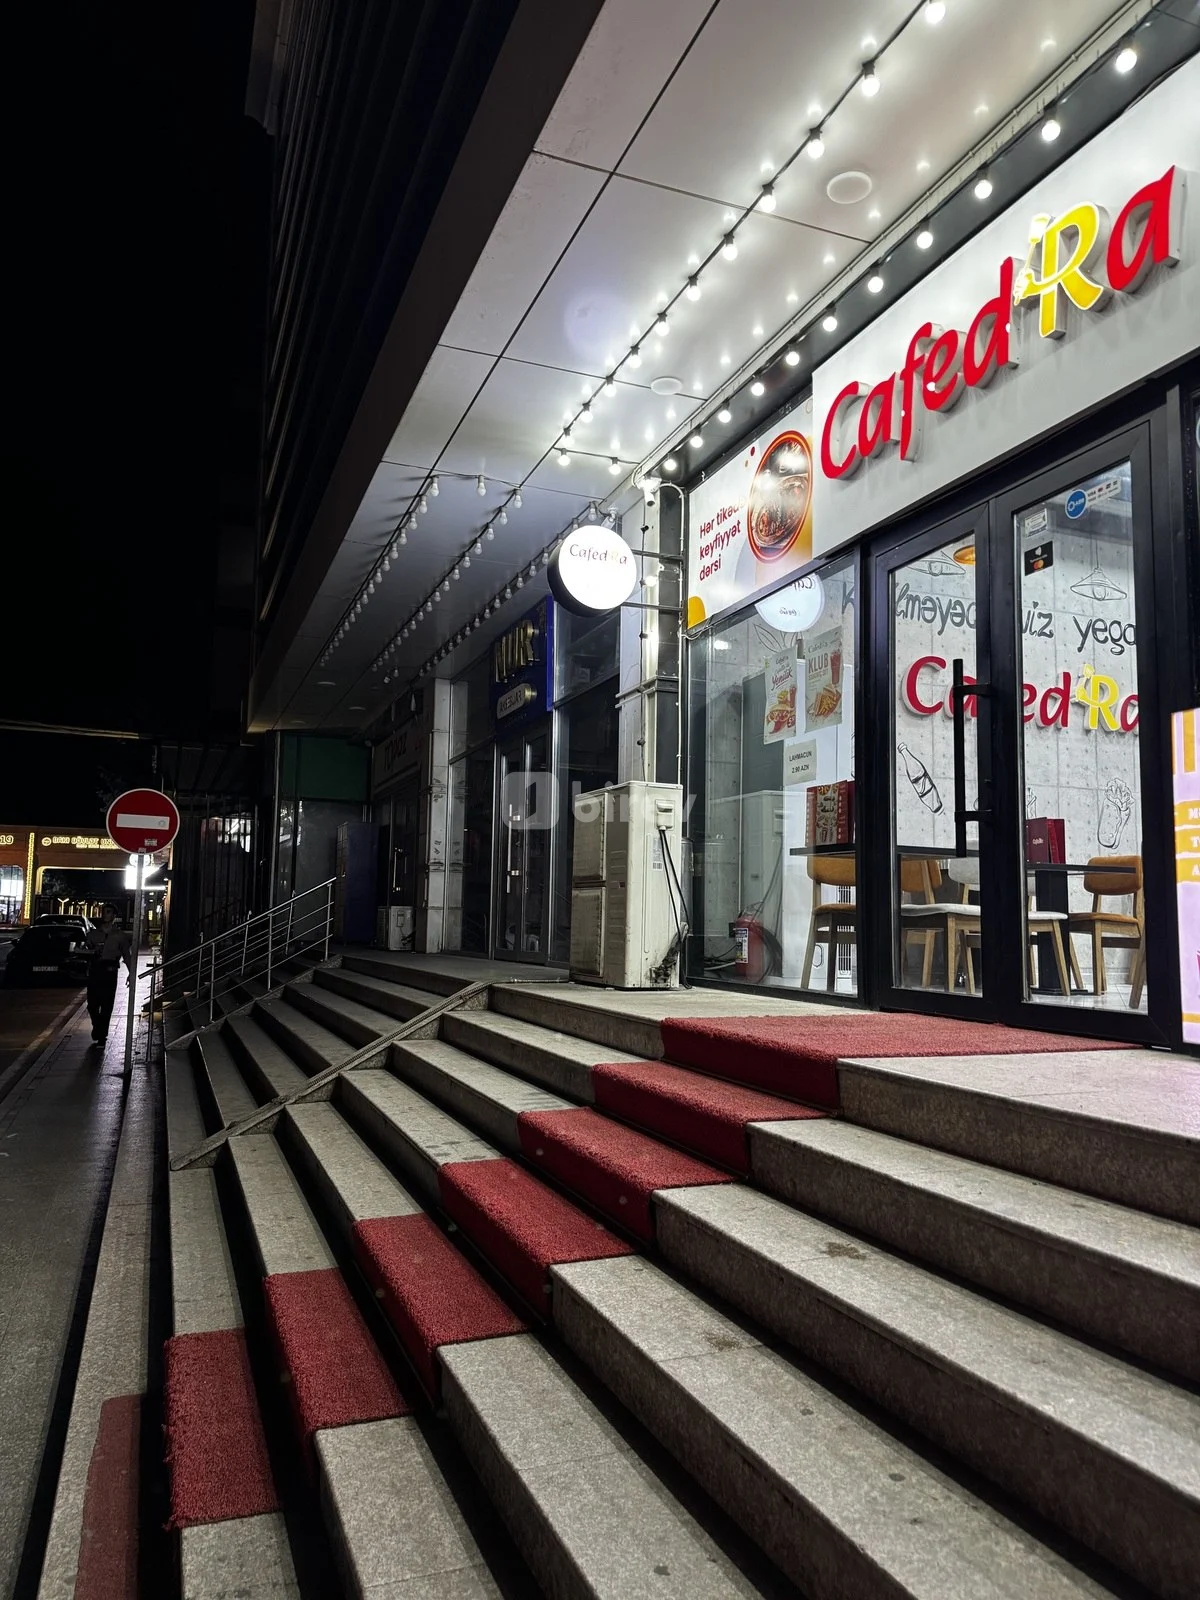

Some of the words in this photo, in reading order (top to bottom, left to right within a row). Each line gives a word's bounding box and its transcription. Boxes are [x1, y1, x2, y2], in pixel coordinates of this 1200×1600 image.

[820, 164, 1175, 479] CafedRa
[699, 518, 715, 539] Hər
[716, 502, 745, 526] tikə
[699, 520, 741, 560] keyfiyyət
[699, 554, 722, 581] dərsi
[1072, 615, 1137, 656] yega
[808, 653, 829, 675] KLUB
[905, 655, 1140, 732] CaedRa
[788, 750, 812, 762] LAHMACUN
